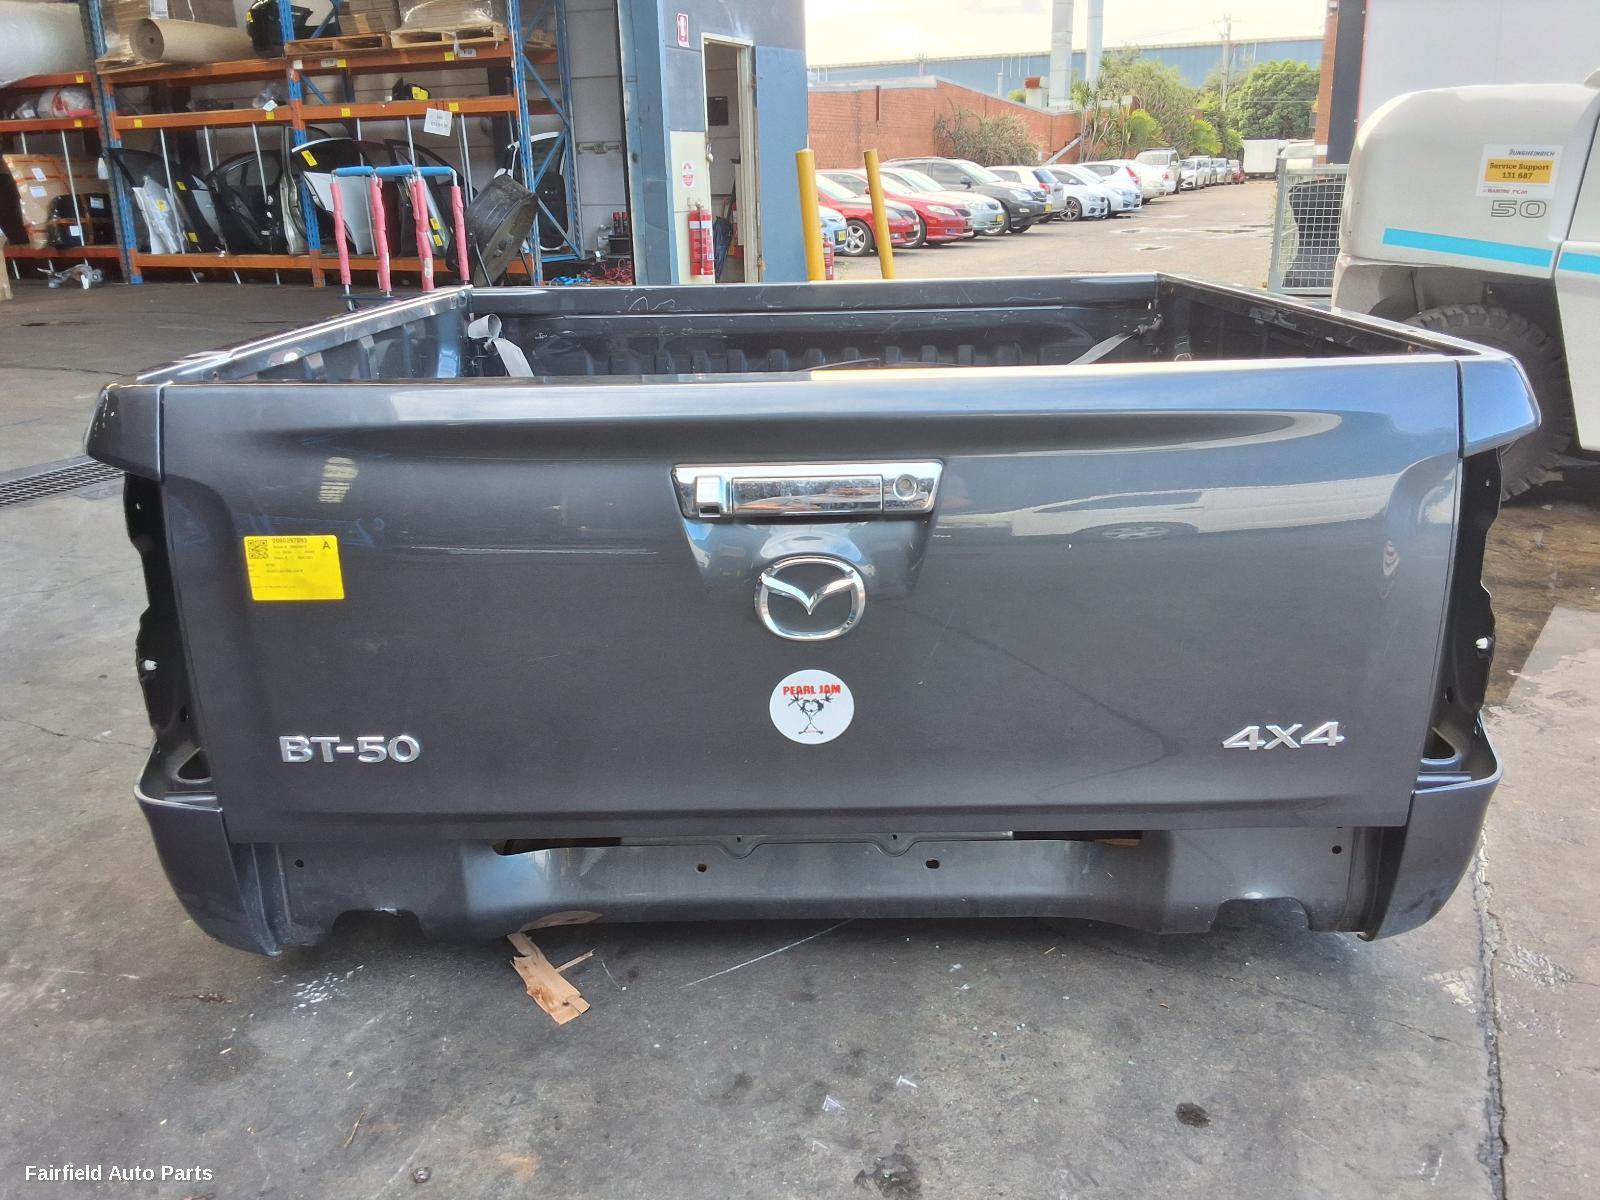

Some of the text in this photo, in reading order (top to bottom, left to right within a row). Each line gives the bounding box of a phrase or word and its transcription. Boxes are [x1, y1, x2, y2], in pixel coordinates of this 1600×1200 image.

[1508, 149, 1555, 157] JUNGHEINRICH
[1489, 162, 1549, 171] Service Support
[1491, 200, 1547, 218] 50
[322, 540, 331, 550] A
[783, 684, 841, 695] PEARL JAM
[1222, 721, 1345, 751] 4X4
[279, 735, 421, 763] BT-50
